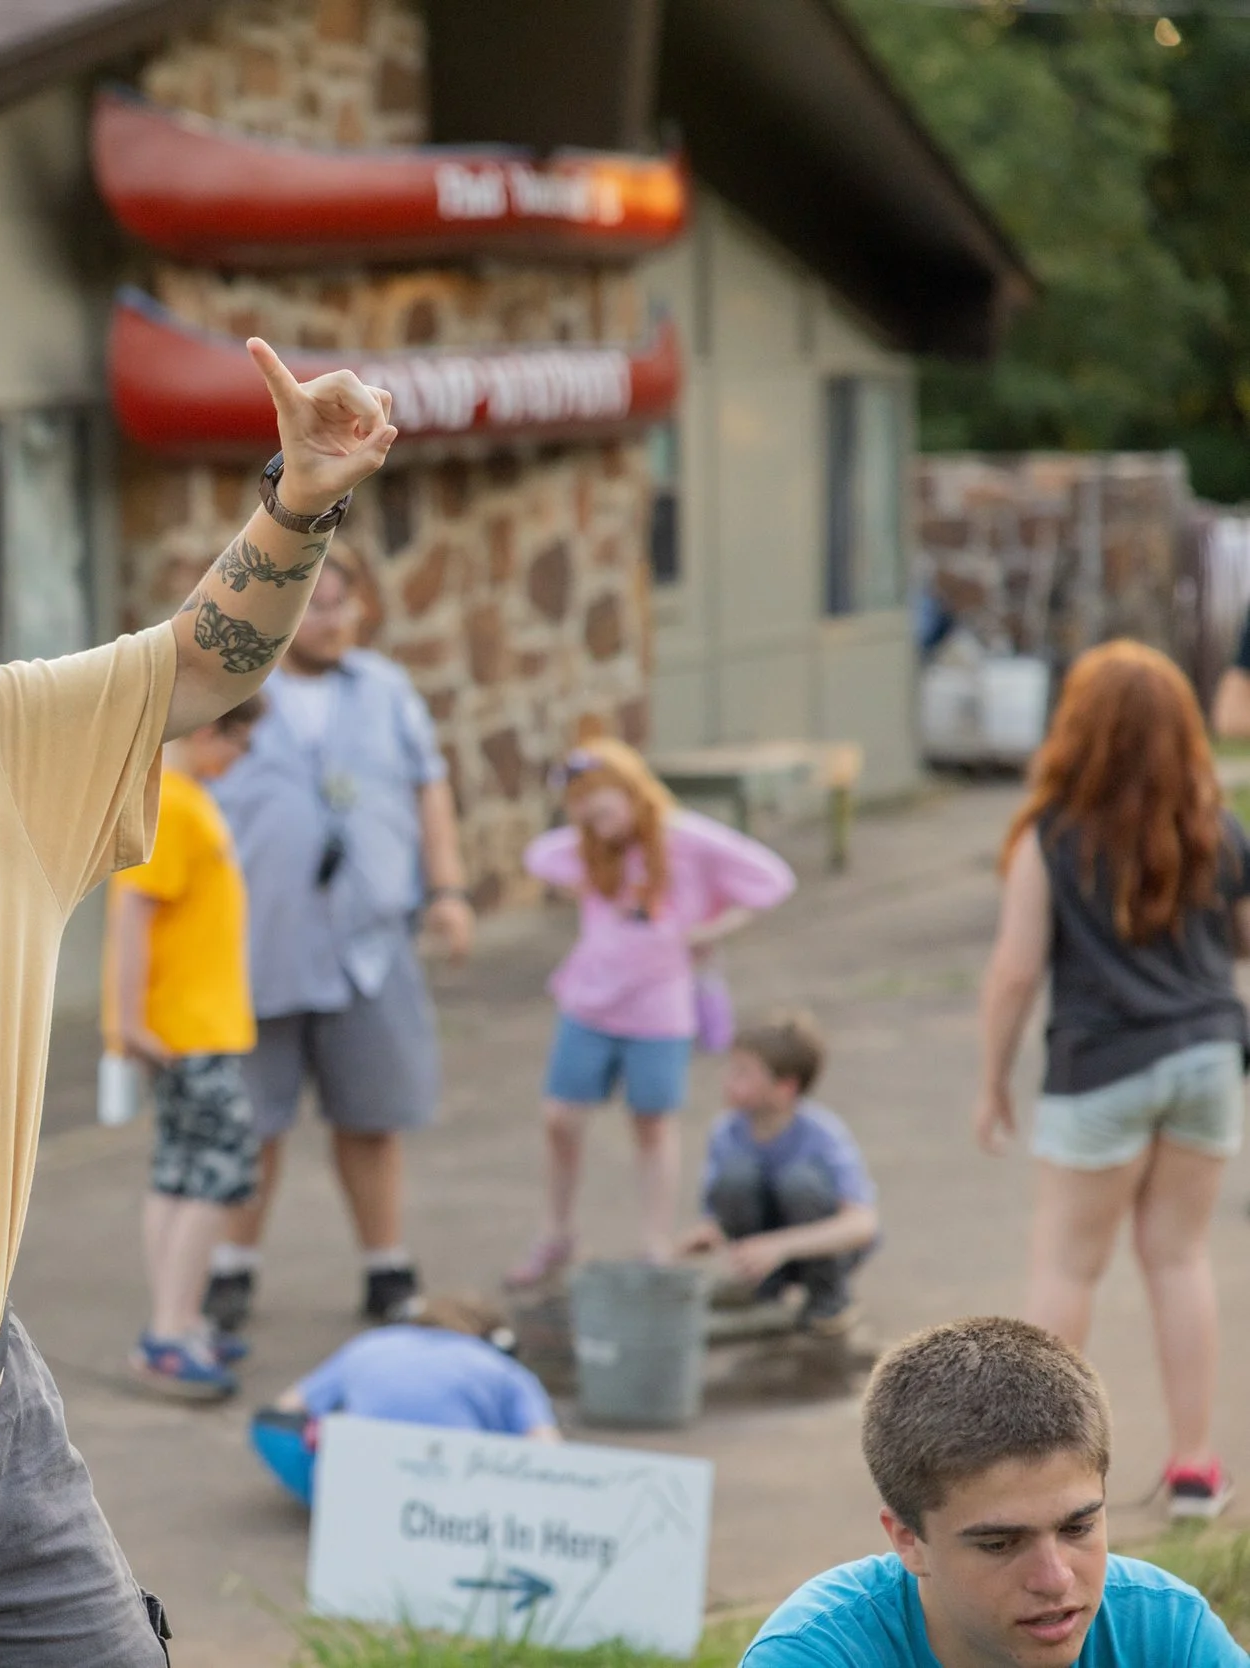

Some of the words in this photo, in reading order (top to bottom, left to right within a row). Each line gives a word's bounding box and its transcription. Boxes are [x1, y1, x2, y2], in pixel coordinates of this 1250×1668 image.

[399, 1498, 492, 1547] Check
[502, 1512, 536, 1552] In
[540, 1516, 619, 1564] Here
